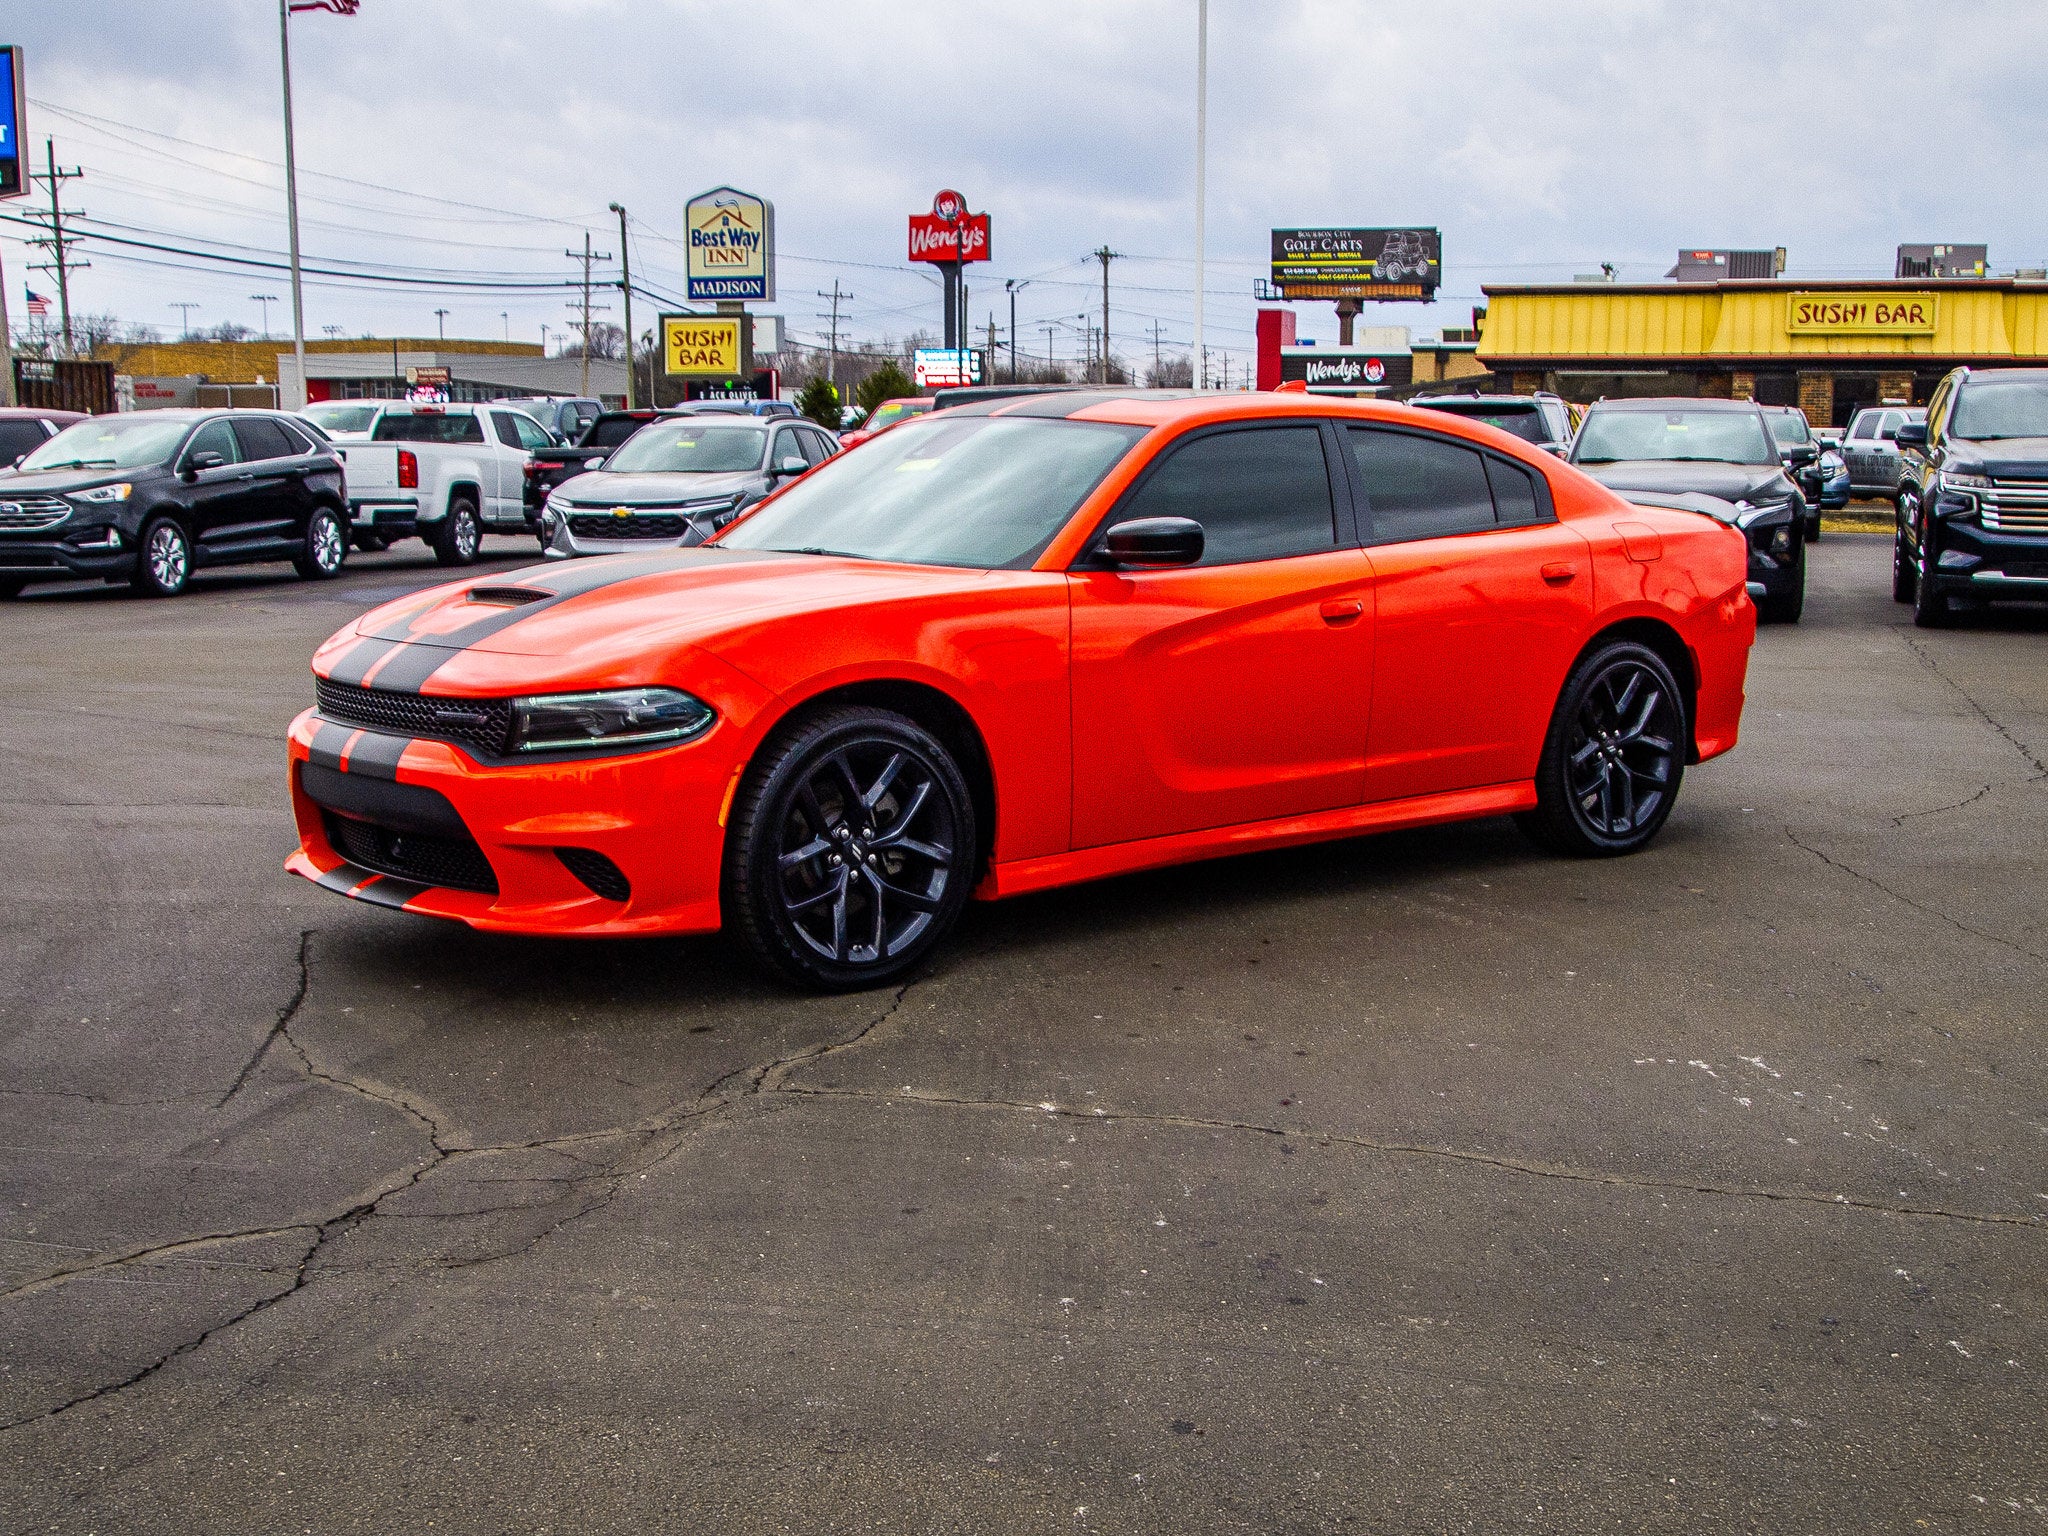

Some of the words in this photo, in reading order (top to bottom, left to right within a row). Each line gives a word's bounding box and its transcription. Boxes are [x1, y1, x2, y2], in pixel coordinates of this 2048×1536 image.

[691, 228, 726, 247] Best
[727, 227, 760, 253] Way
[911, 223, 985, 255] Wendy's
[1283, 238, 1318, 252] GOLF
[1321, 238, 1363, 252] CARTS
[707, 249, 744, 263] INN
[692, 281, 761, 295] MADISON
[1797, 303, 1867, 324] SUSHI
[1875, 303, 1926, 324] BAR
[672, 330, 732, 347] SUSHI
[680, 349, 724, 366] BAR
[1306, 358, 1361, 384] Wendy's
